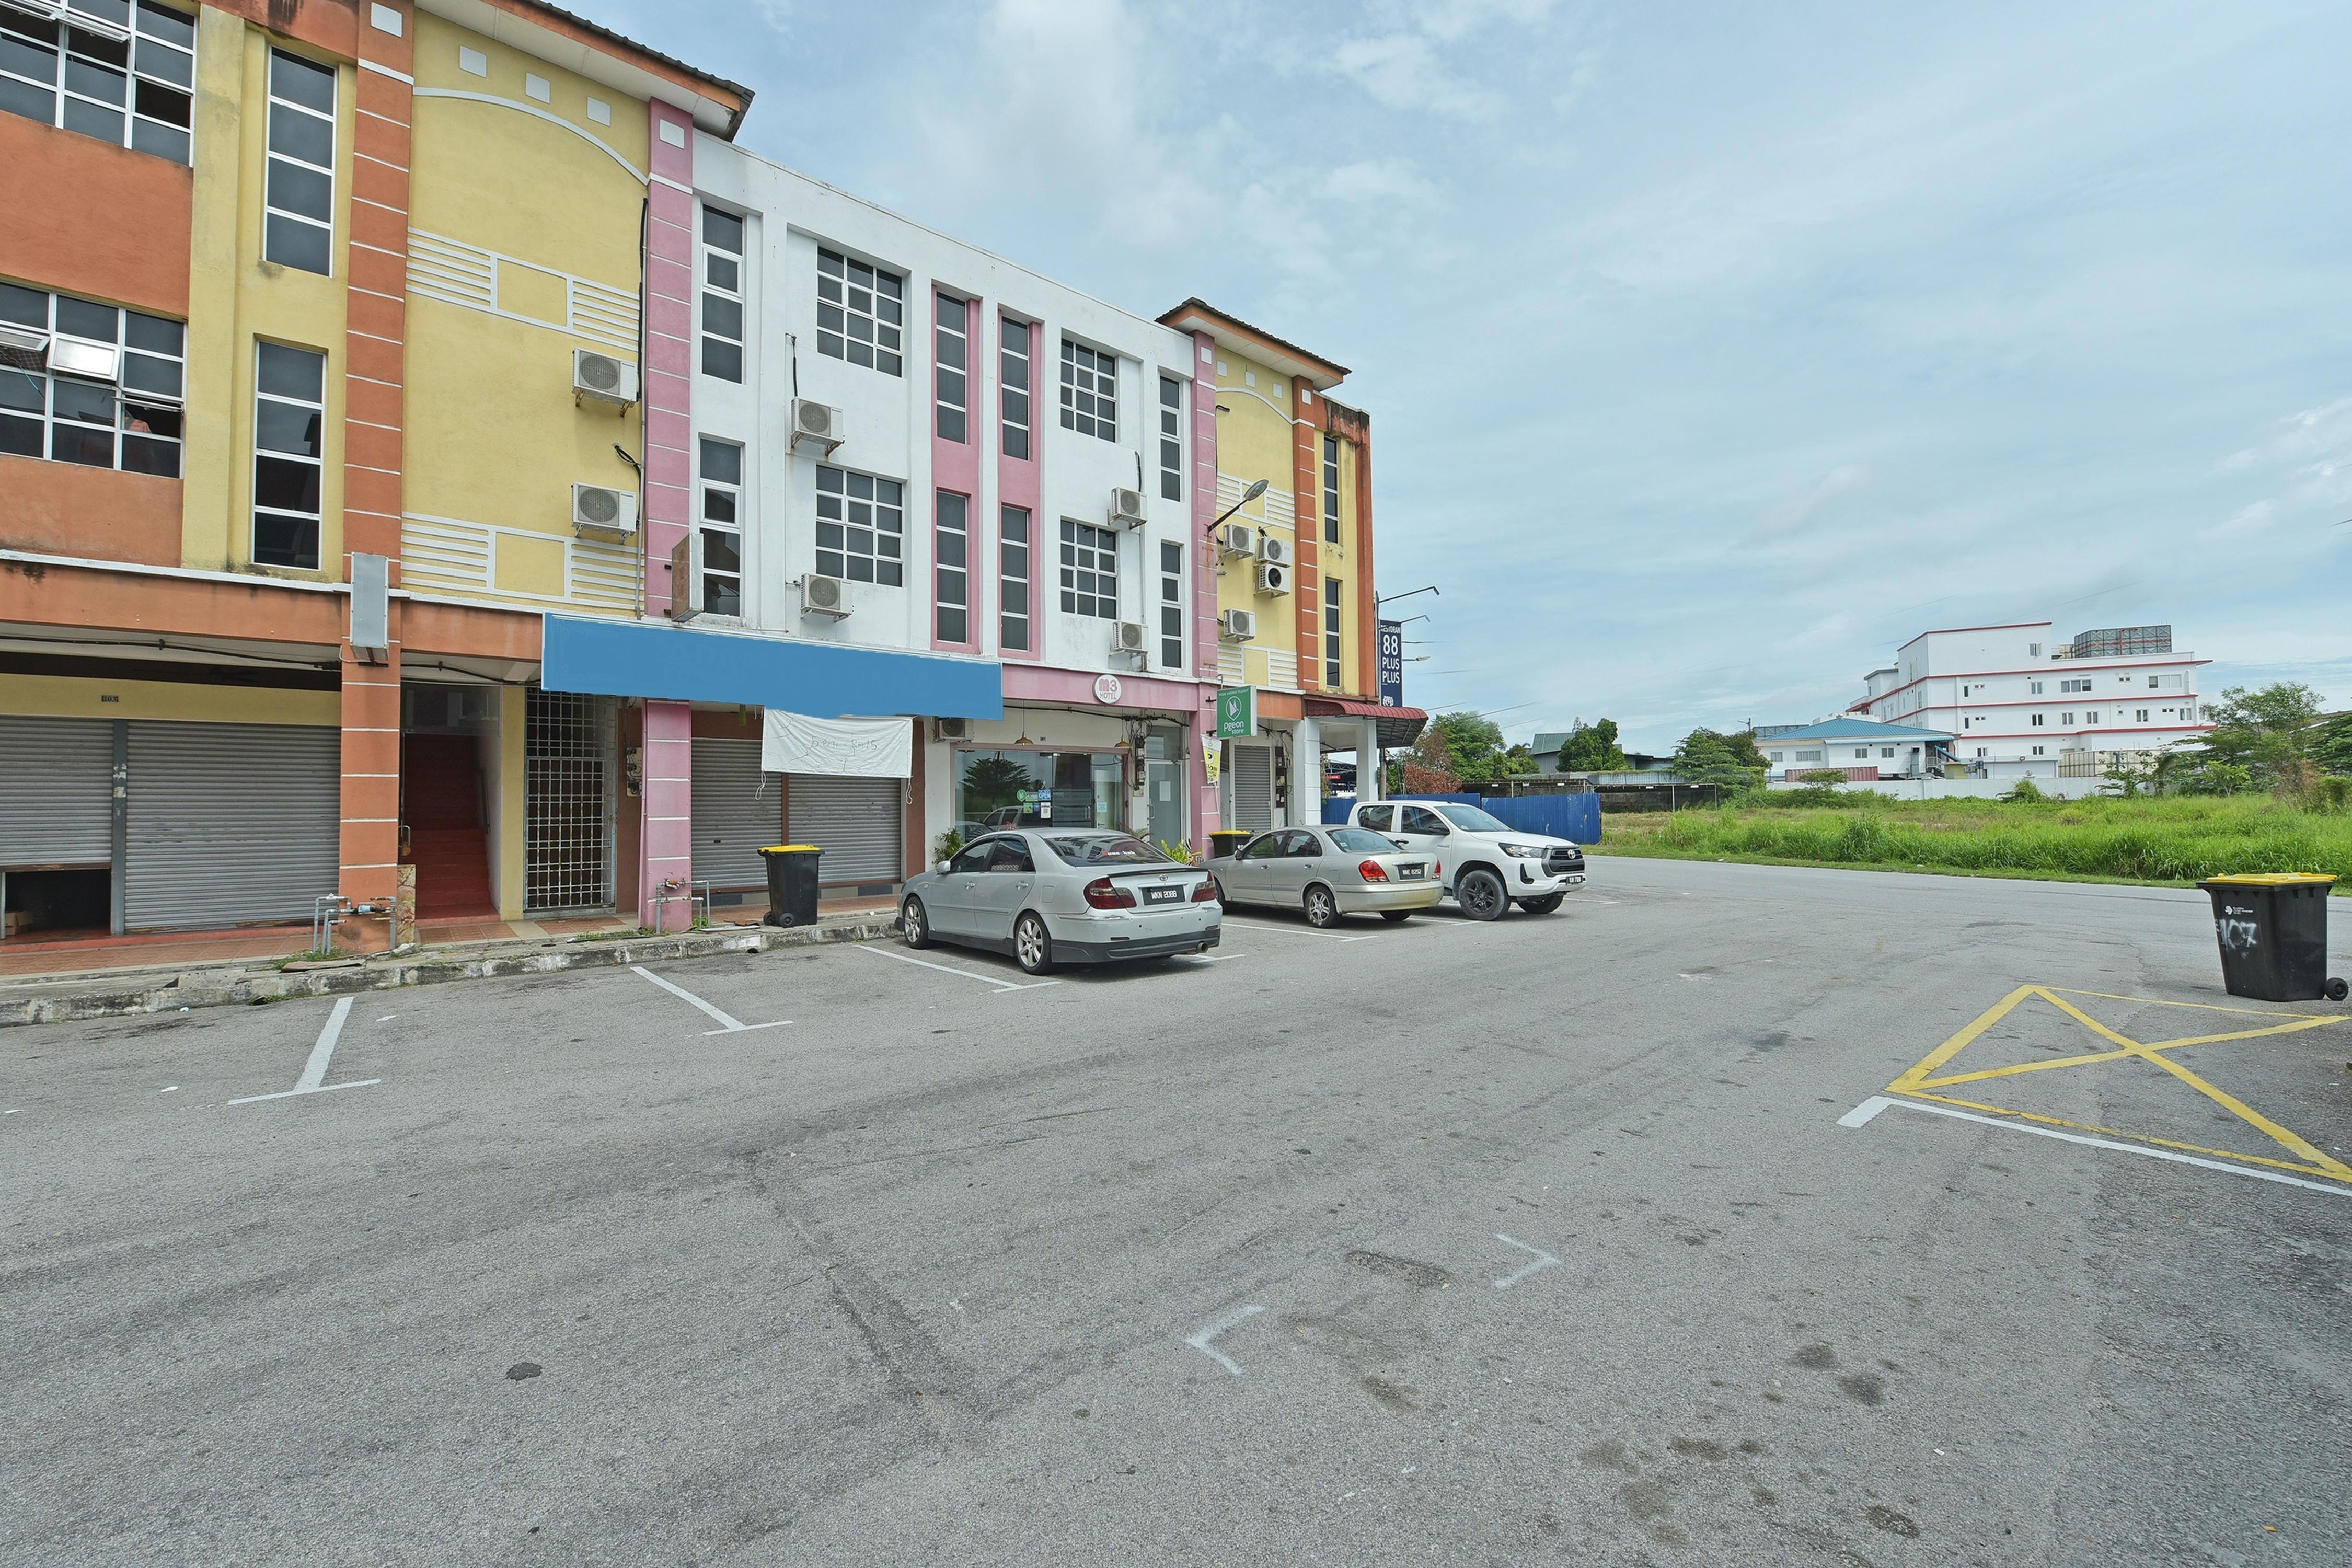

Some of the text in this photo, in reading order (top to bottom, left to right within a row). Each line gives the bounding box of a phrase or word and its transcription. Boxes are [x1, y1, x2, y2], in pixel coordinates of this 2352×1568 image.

[1383, 634, 1398, 655] 88
[1382, 656, 1400, 670] PLUS
[1382, 671, 1400, 684] PLUS
[1100, 691, 1117, 700] HOTEL
[1224, 721, 1244, 732] Pgeon
